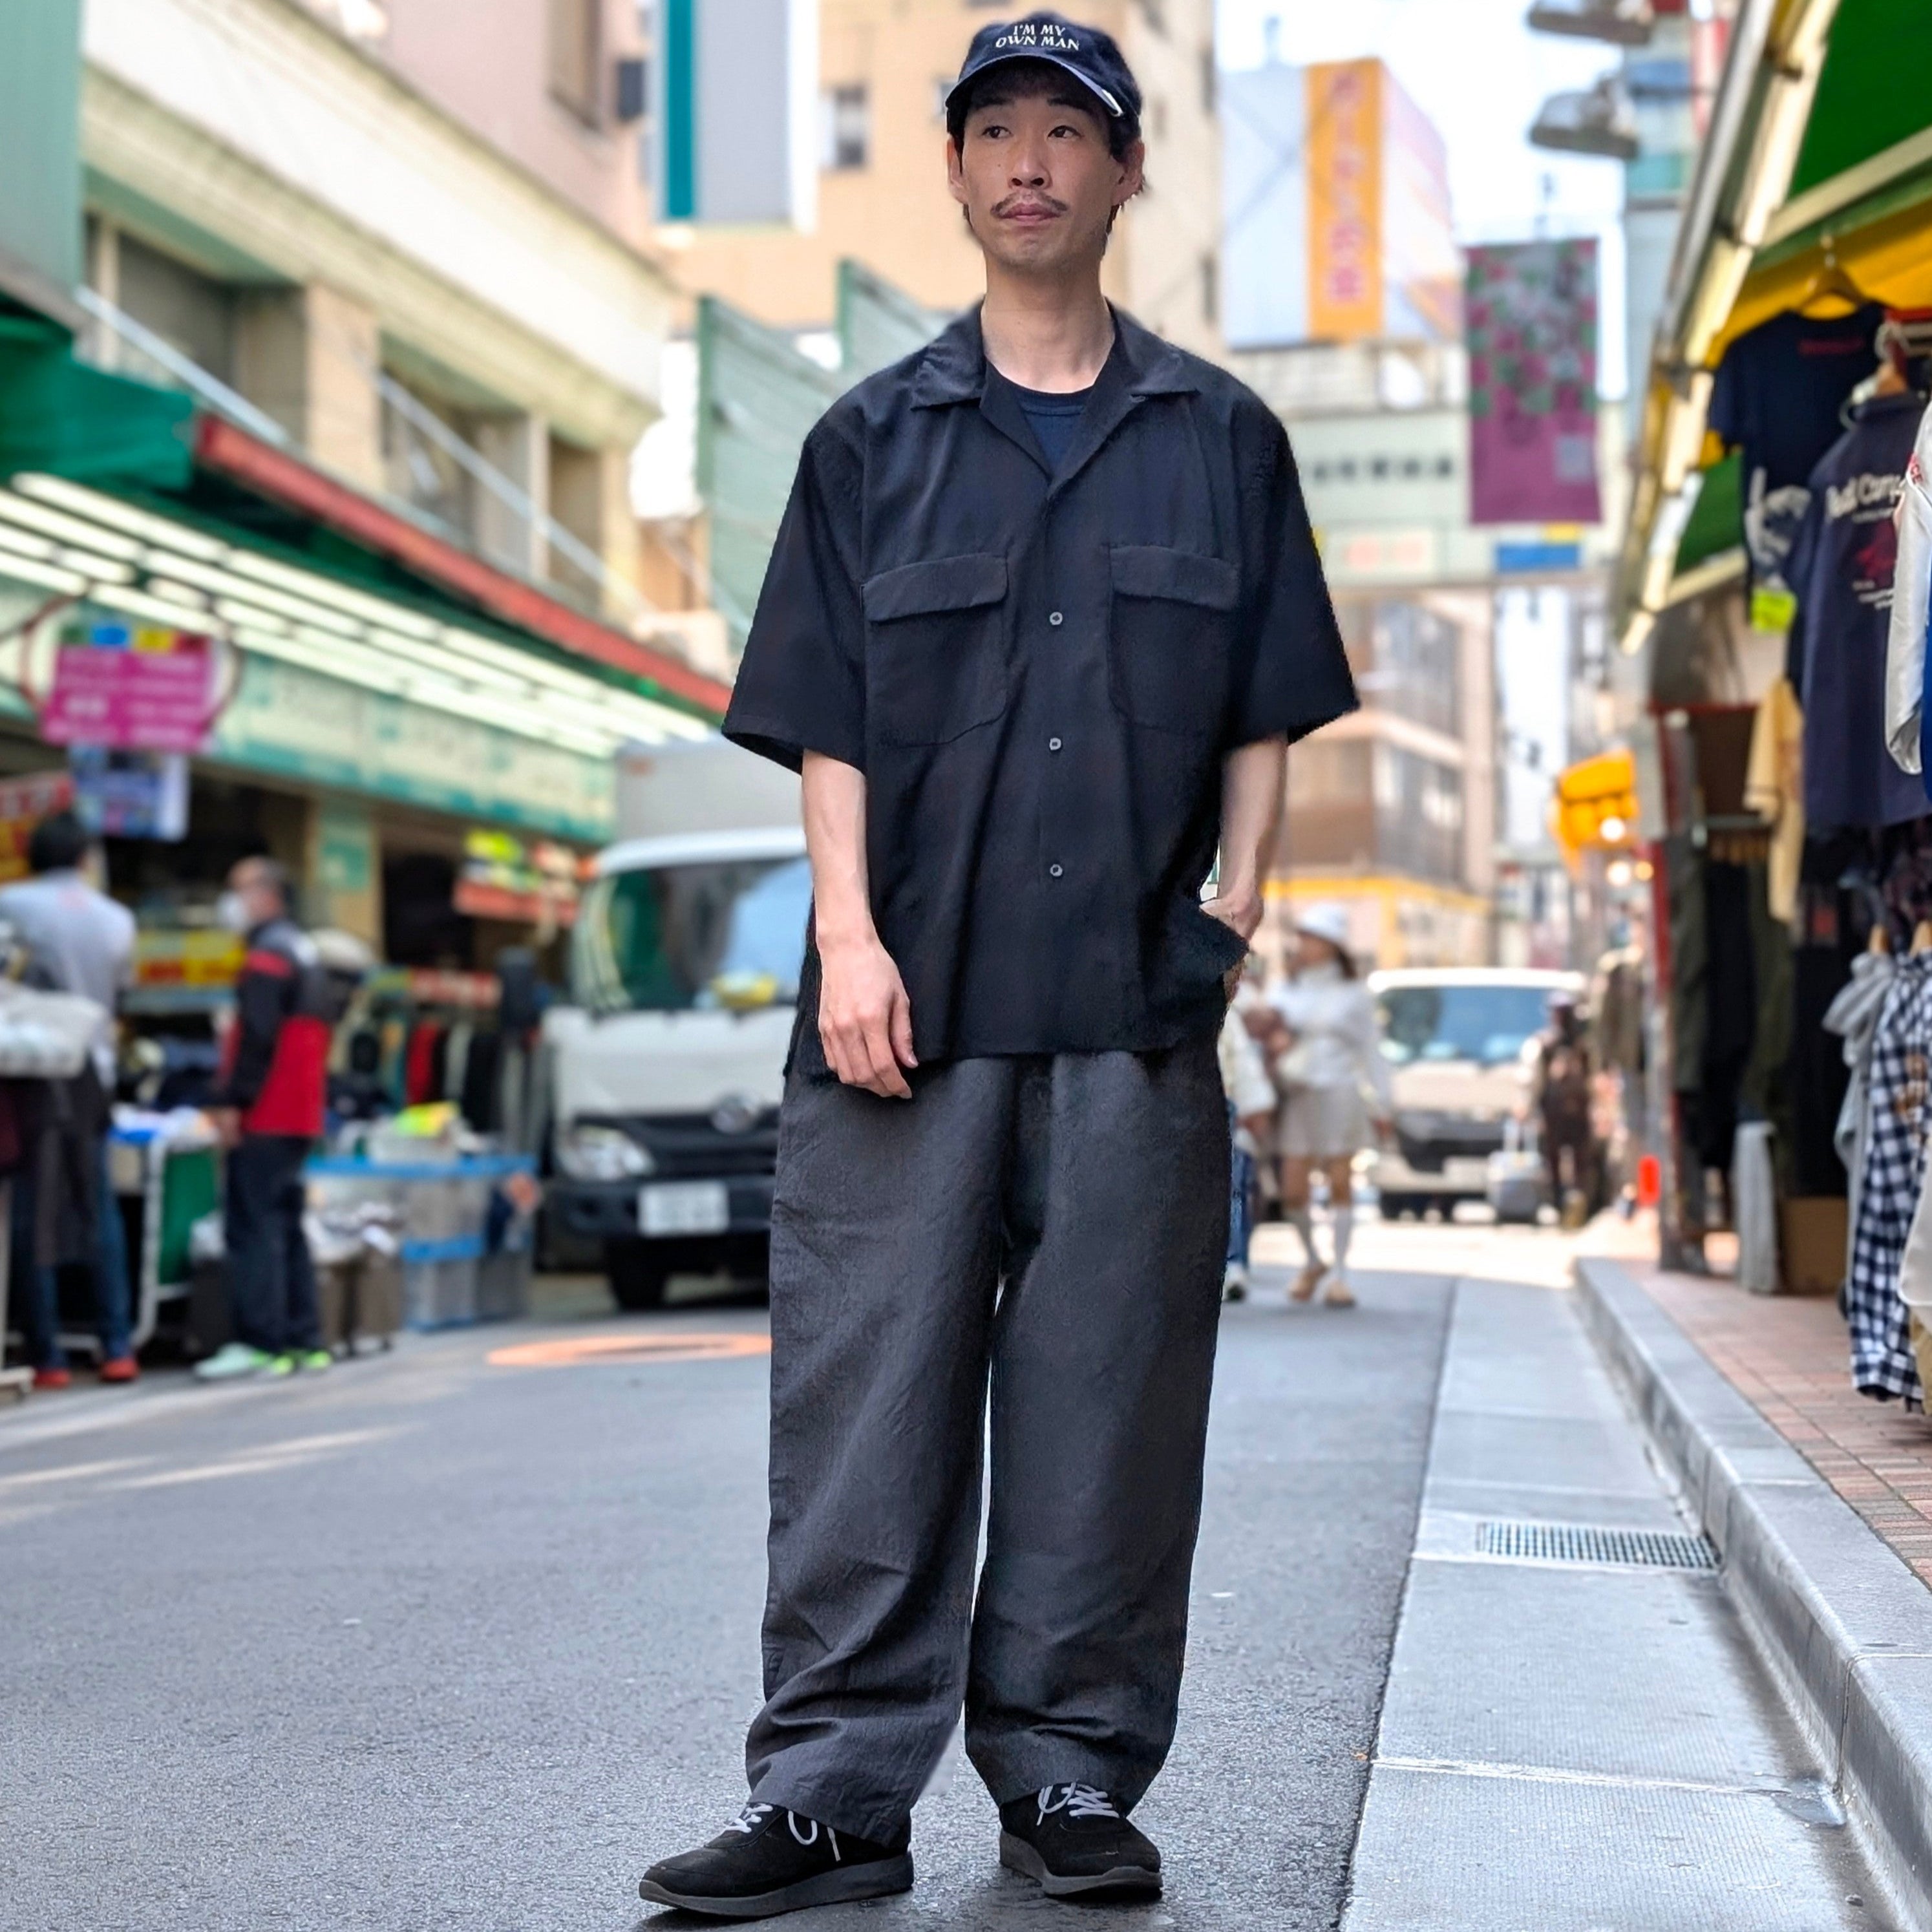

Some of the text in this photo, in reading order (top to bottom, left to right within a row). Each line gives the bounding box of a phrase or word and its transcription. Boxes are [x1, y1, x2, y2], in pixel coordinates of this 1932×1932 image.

[1013, 24, 1066, 37] I'M MY
[995, 36, 1079, 51] OWN MAN
